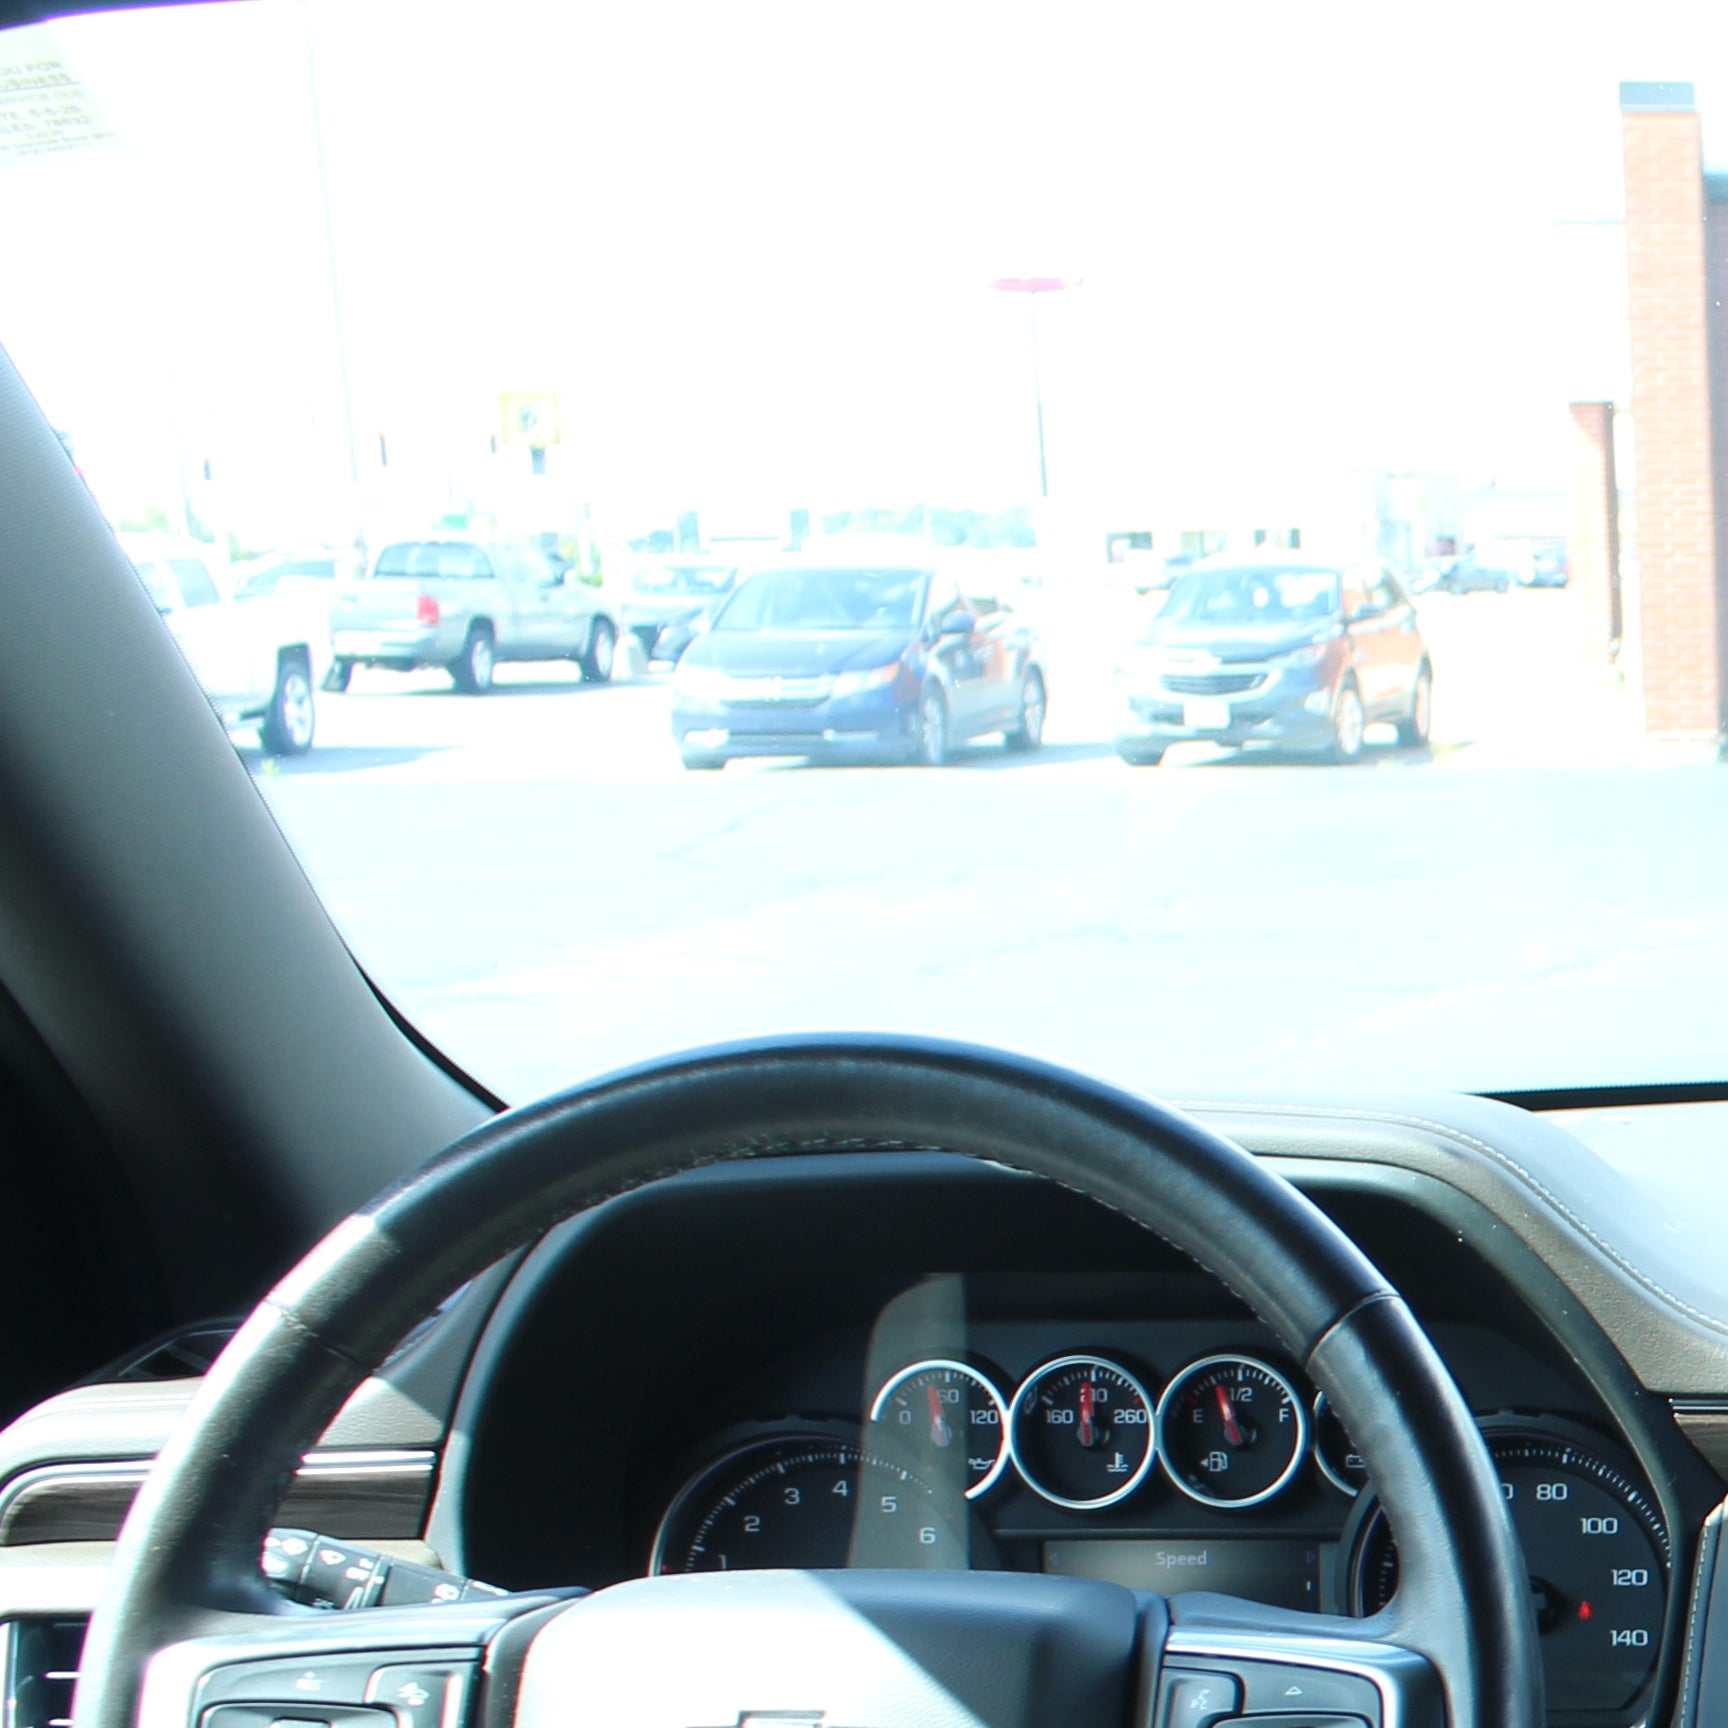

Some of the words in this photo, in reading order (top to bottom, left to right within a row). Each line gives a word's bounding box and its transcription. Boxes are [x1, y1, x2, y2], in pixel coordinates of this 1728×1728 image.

[1230, 1387, 1254, 1403] 1/2
[899, 1410, 912, 1425] 0
[970, 1409, 999, 1425] 120
[1046, 1409, 1075, 1425] 160
[1113, 1408, 1148, 1425] 260
[1193, 1408, 1204, 1425] E
[1278, 1408, 1290, 1424] F
[784, 1487, 801, 1505] 3
[832, 1480, 849, 1497] 4
[1536, 1483, 1569, 1501] 80
[880, 1496, 898, 1513] 5
[744, 1515, 761, 1532] 2
[1580, 1516, 1619, 1535] 100
[918, 1526, 937, 1545] 6
[1155, 1550, 1208, 1570] Speed
[1611, 1568, 1649, 1587] 120
[1610, 1628, 1650, 1648] 140
